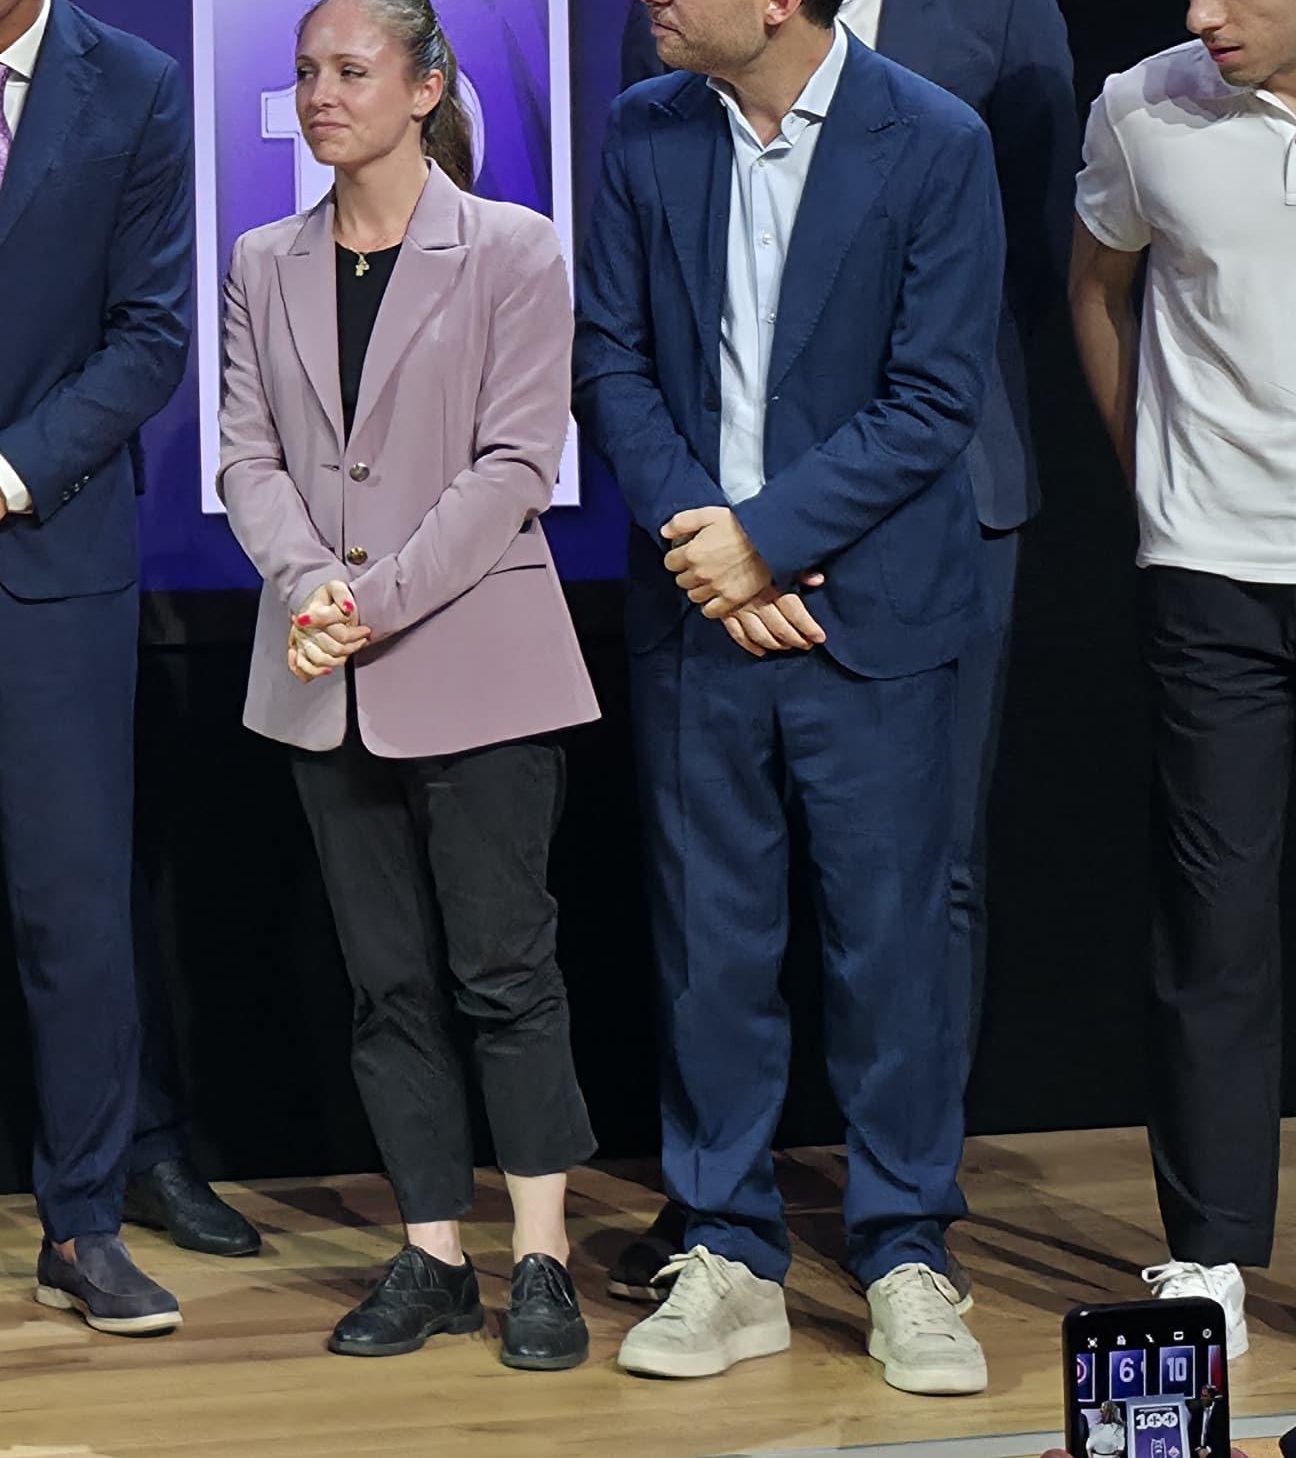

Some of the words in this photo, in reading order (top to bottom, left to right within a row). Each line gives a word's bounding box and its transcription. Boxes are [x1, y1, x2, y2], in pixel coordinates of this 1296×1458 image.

[1119, 1357, 1135, 1383] 6
[1166, 1356, 1188, 1382] 10
[1136, 1412, 1178, 1429] 100
